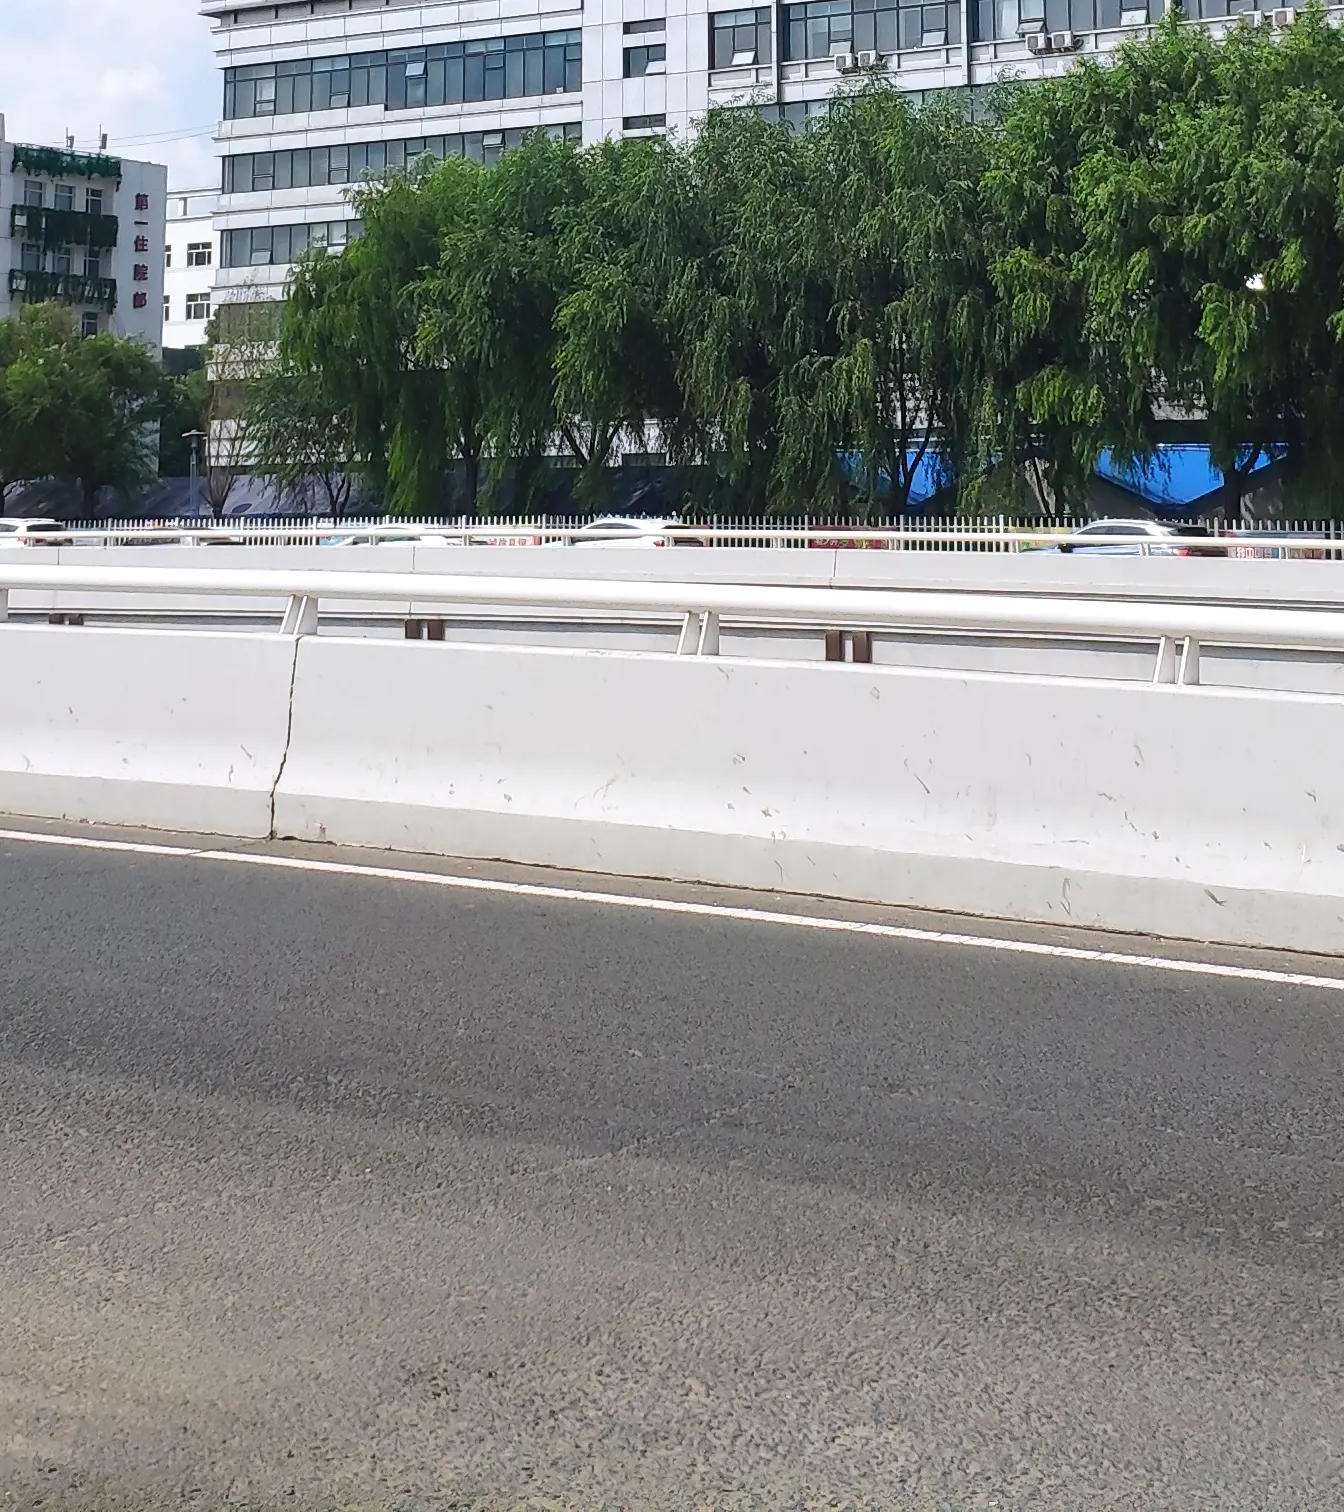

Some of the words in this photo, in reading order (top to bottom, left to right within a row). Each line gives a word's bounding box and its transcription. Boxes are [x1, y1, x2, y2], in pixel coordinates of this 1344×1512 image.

[133, 192, 149, 309] 第一住院部
